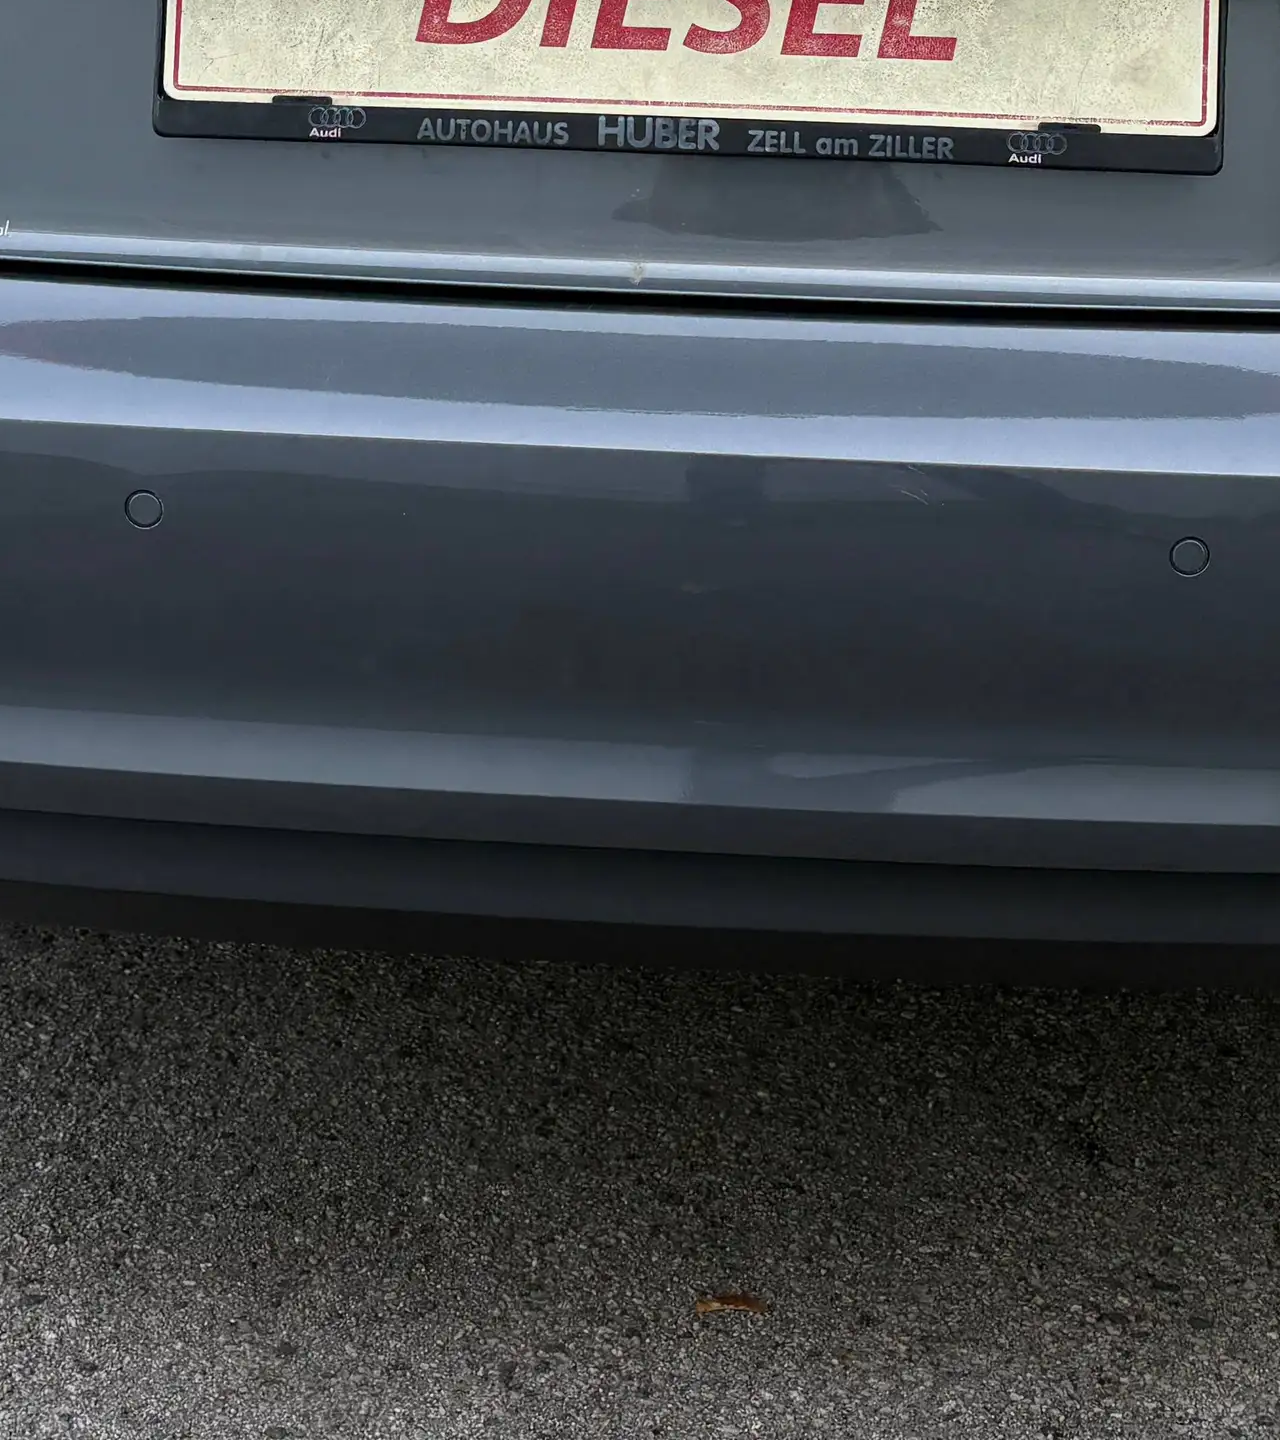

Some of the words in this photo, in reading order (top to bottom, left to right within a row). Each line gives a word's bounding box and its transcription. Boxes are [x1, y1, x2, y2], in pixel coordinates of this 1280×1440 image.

[309, 126, 342, 139] Audi
[416, 116, 570, 146] AUTOHAUS
[596, 113, 721, 151] HUBER
[746, 128, 807, 155] ZELL
[815, 137, 860, 157] am
[868, 132, 956, 161] ZILLER
[1008, 152, 1043, 164] Audi
